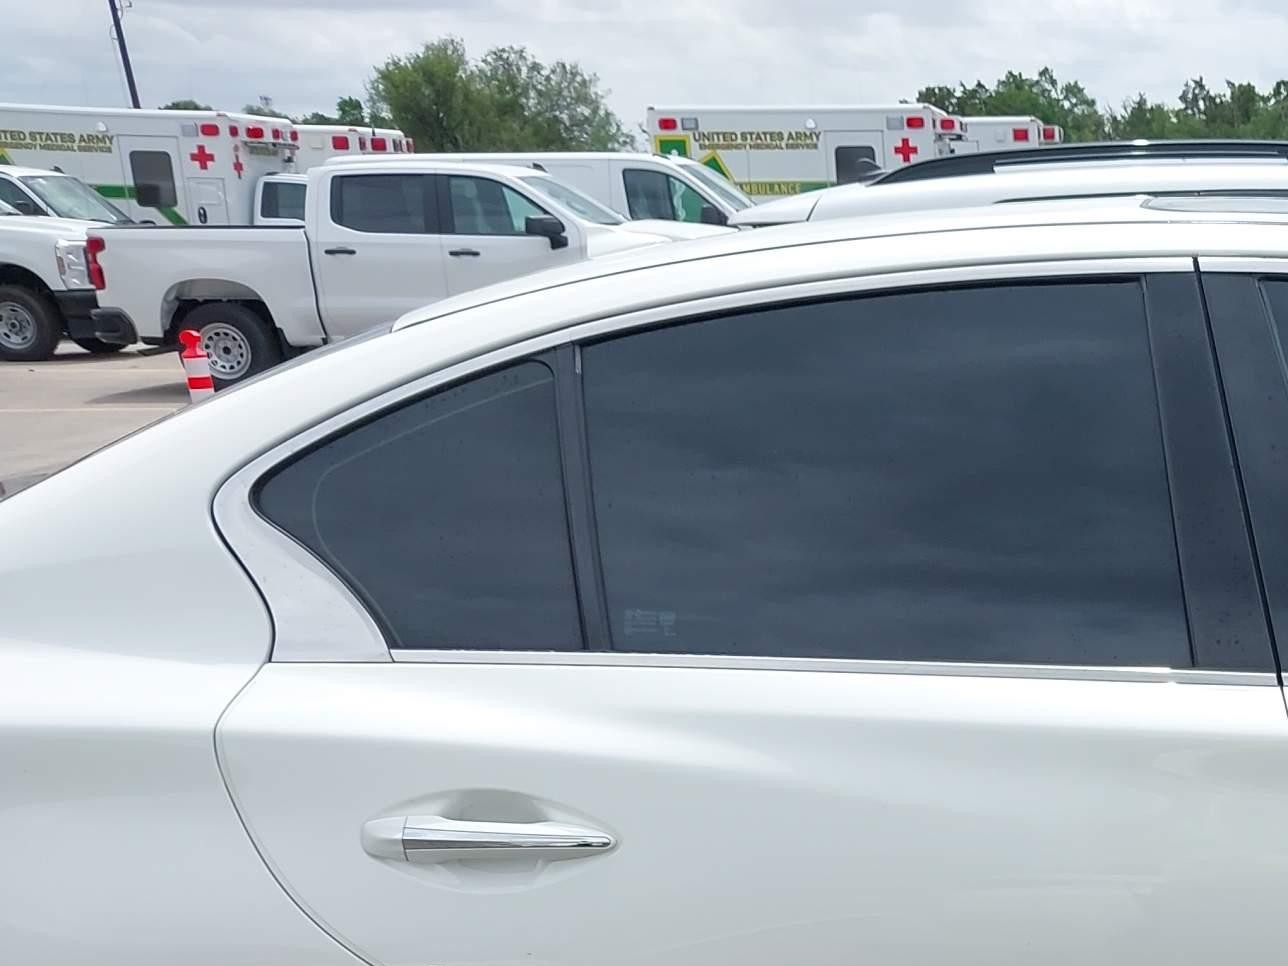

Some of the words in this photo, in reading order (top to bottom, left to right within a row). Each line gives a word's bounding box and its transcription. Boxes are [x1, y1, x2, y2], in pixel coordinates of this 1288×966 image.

[29, 131, 76, 143] STATES
[78, 133, 114, 145] ARMY
[692, 131, 738, 143] UNITED
[740, 131, 784, 142] STATES
[786, 131, 822, 142] ARMY
